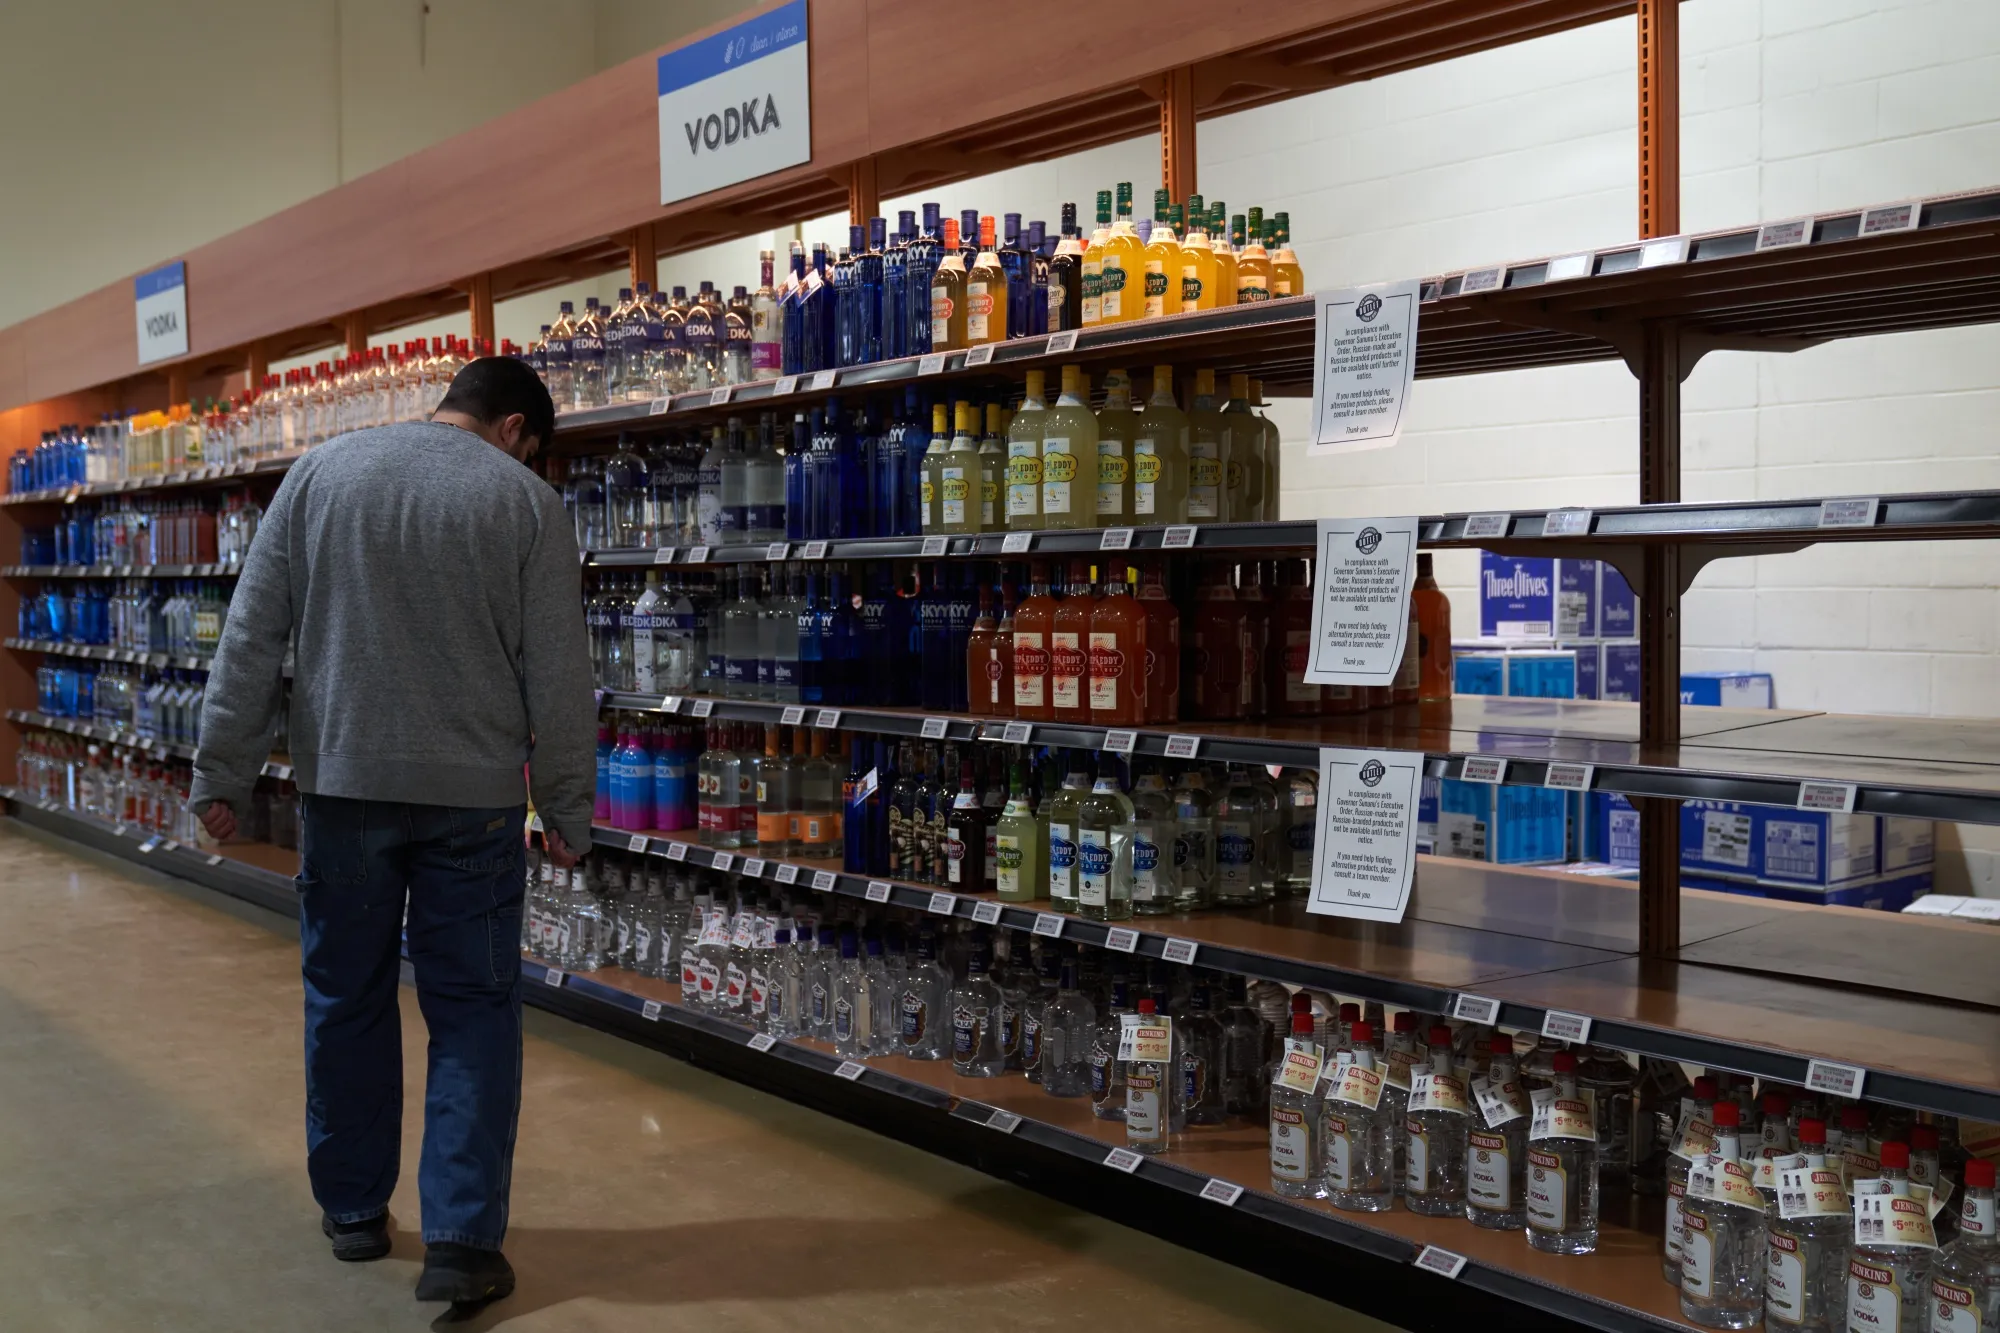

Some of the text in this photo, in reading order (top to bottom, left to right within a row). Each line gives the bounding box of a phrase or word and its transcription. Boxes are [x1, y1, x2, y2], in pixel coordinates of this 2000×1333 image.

[685, 93, 781, 155] VODKA
[908, 246, 930, 260] KYY
[883, 253, 903, 266] KYY
[835, 267, 854, 280] KYY
[145, 312, 178, 338] VODKA
[686, 324, 715, 336] VEDKA
[622, 325, 647, 337] EDKA
[1351, 326, 1377, 336] compliance
[573, 337, 602, 349] VEDKA
[1334, 338, 1355, 346] Governor
[1379, 332, 1402, 341] Executive
[1371, 352, 1391, 361] products
[1348, 363, 1368, 372] available
[1370, 361, 1381, 369] until
[1382, 360, 1399, 368] further
[1374, 388, 1390, 396] finding
[1330, 401, 1355, 409] alternative
[1379, 397, 1394, 406] please
[1334, 410, 1350, 418] consult
[812, 438, 836, 450] SKYY
[1350, 558, 1376, 567] compliance
[921, 604, 950, 617] SKYY
[652, 617, 677, 627] EDKA
[1360, 622, 1369, 631] help
[1371, 622, 1387, 631] finding
[1354, 791, 1380, 799] compliance
[1337, 798, 1358, 806] Governor
[1381, 801, 1403, 809] Executive
[1372, 818, 1393, 827] products
[1350, 826, 1370, 834] available
[1090, 854, 1108, 862] EDDY
[1364, 855, 1374, 864] help
[1376, 856, 1392, 865] finding
[1331, 861, 1356, 870] alternative
[1347, 889, 1361, 897] Thank
[1138, 1030, 1165, 1038] JENKINS
[1290, 1053, 1316, 1068] JENKINS
[1349, 1068, 1378, 1084] JENKINS
[1556, 1101, 1587, 1112] JENKINS
[1471, 1135, 1500, 1148] JENKINS
[1474, 1173, 1495, 1182] VODKA
[1894, 1201, 1924, 1214] JENKINS
[1893, 1220, 1903, 1230] $5
[1852, 1263, 1887, 1283] JENKINS
[1853, 1308, 1879, 1324] VODKA
